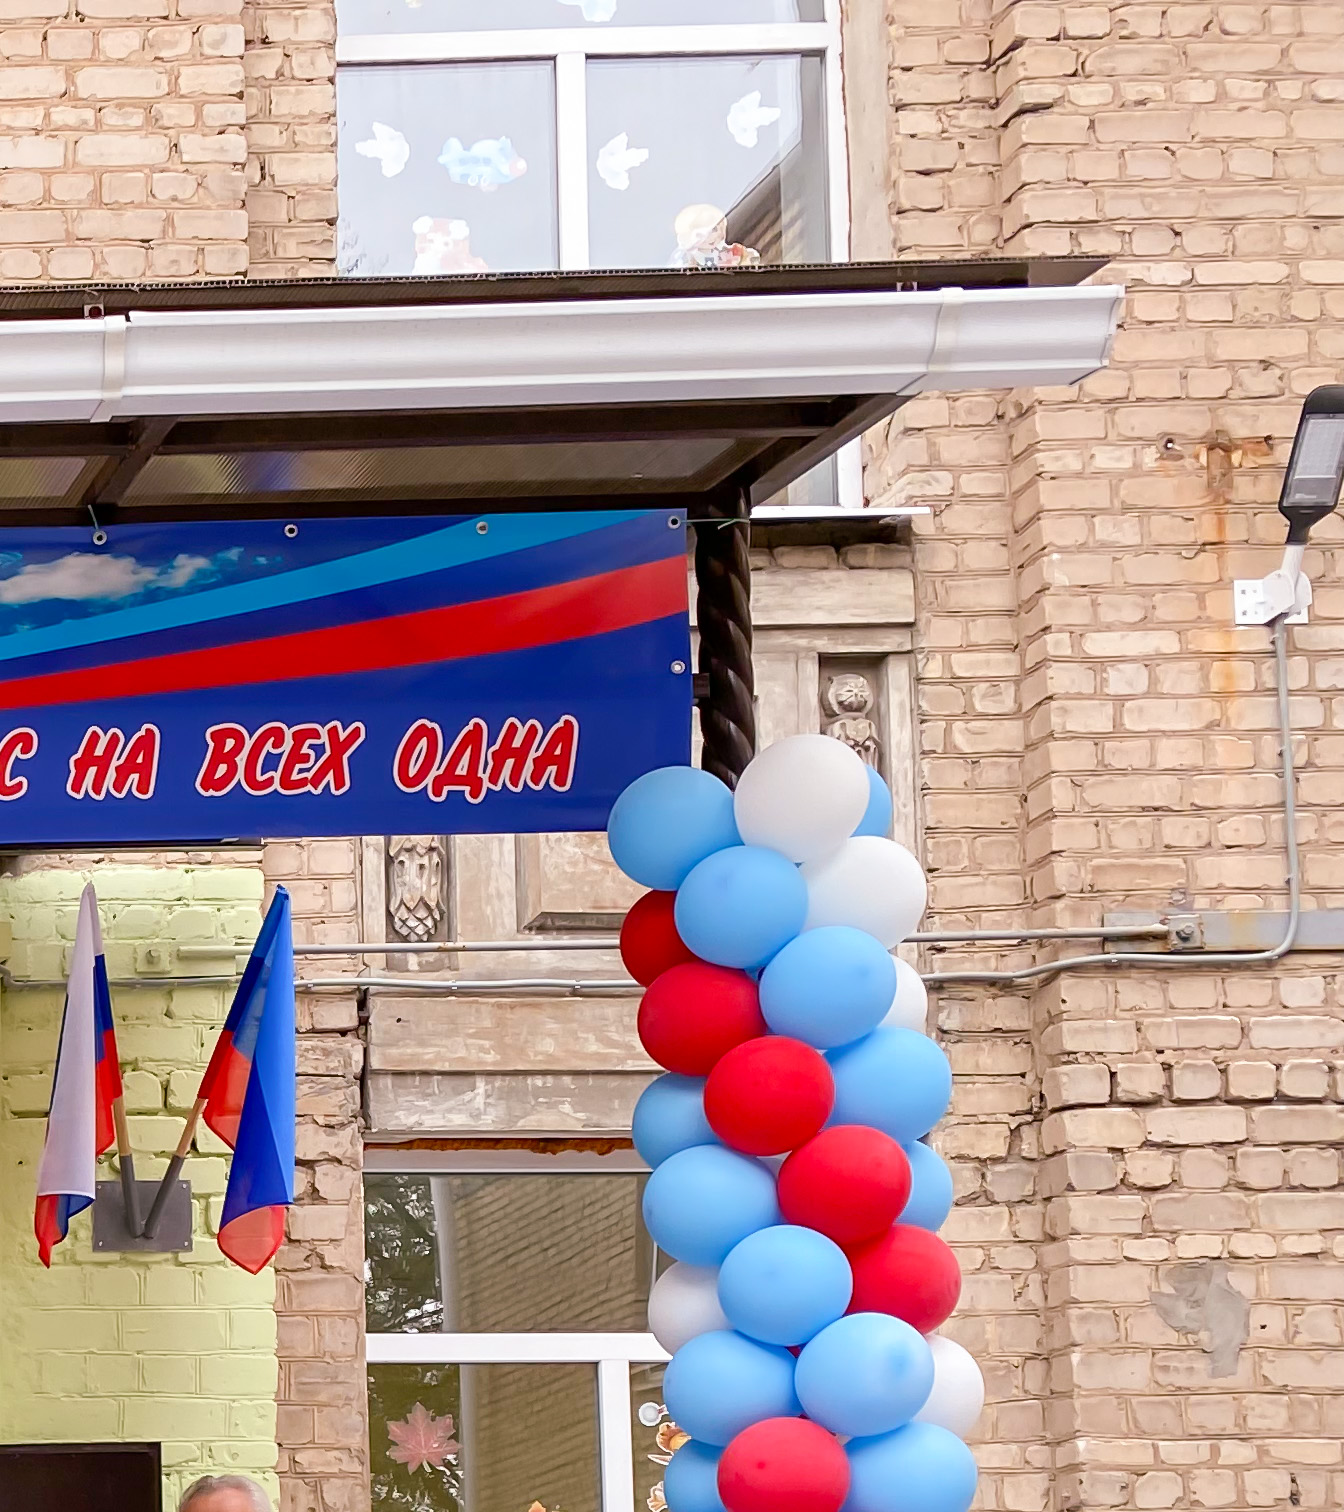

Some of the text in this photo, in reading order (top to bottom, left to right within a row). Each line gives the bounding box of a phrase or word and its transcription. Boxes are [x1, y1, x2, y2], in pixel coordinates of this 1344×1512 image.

[65, 722, 161, 800] НА
[195, 720, 365, 797] ВСЕХ
[392, 714, 579, 805] ОДНА
